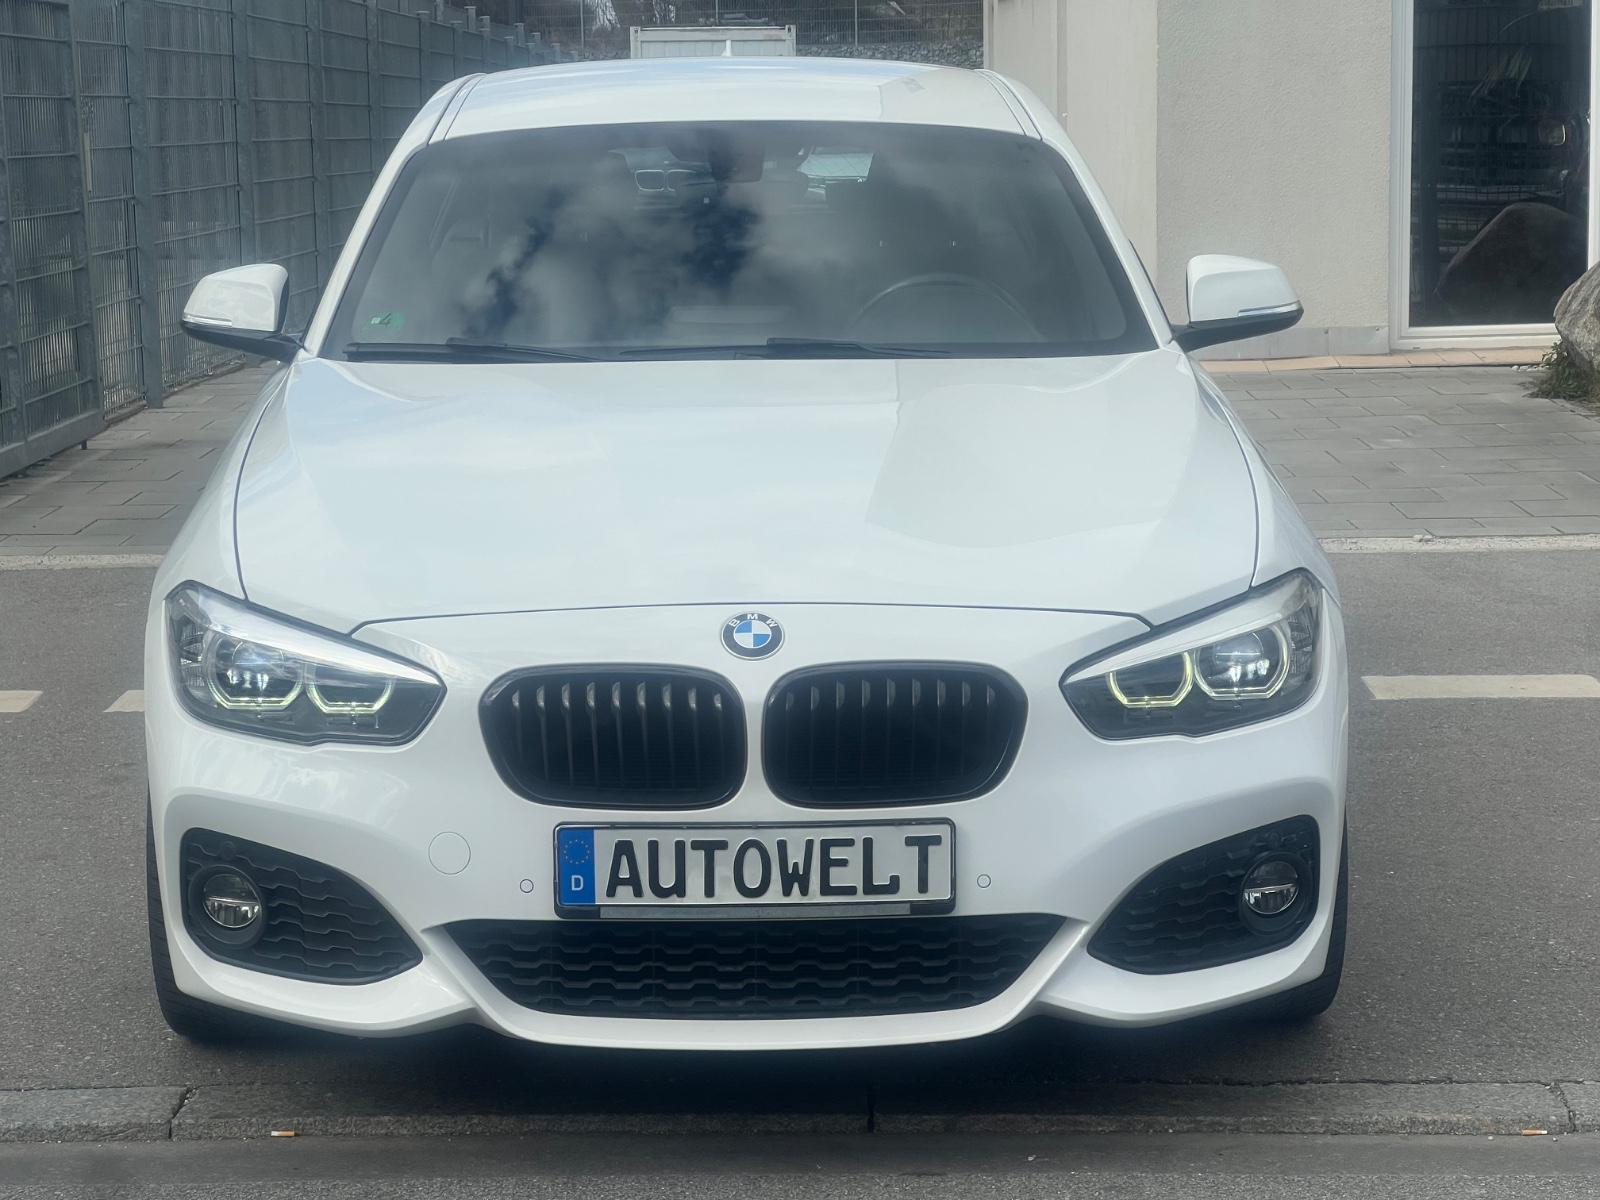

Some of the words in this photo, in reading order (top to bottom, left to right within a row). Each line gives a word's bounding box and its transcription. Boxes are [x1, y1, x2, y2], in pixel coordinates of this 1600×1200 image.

[379, 312, 392, 327] 4
[728, 613, 778, 627] BMW
[605, 834, 942, 898] AUTOWELT
[571, 875, 584, 891] D
